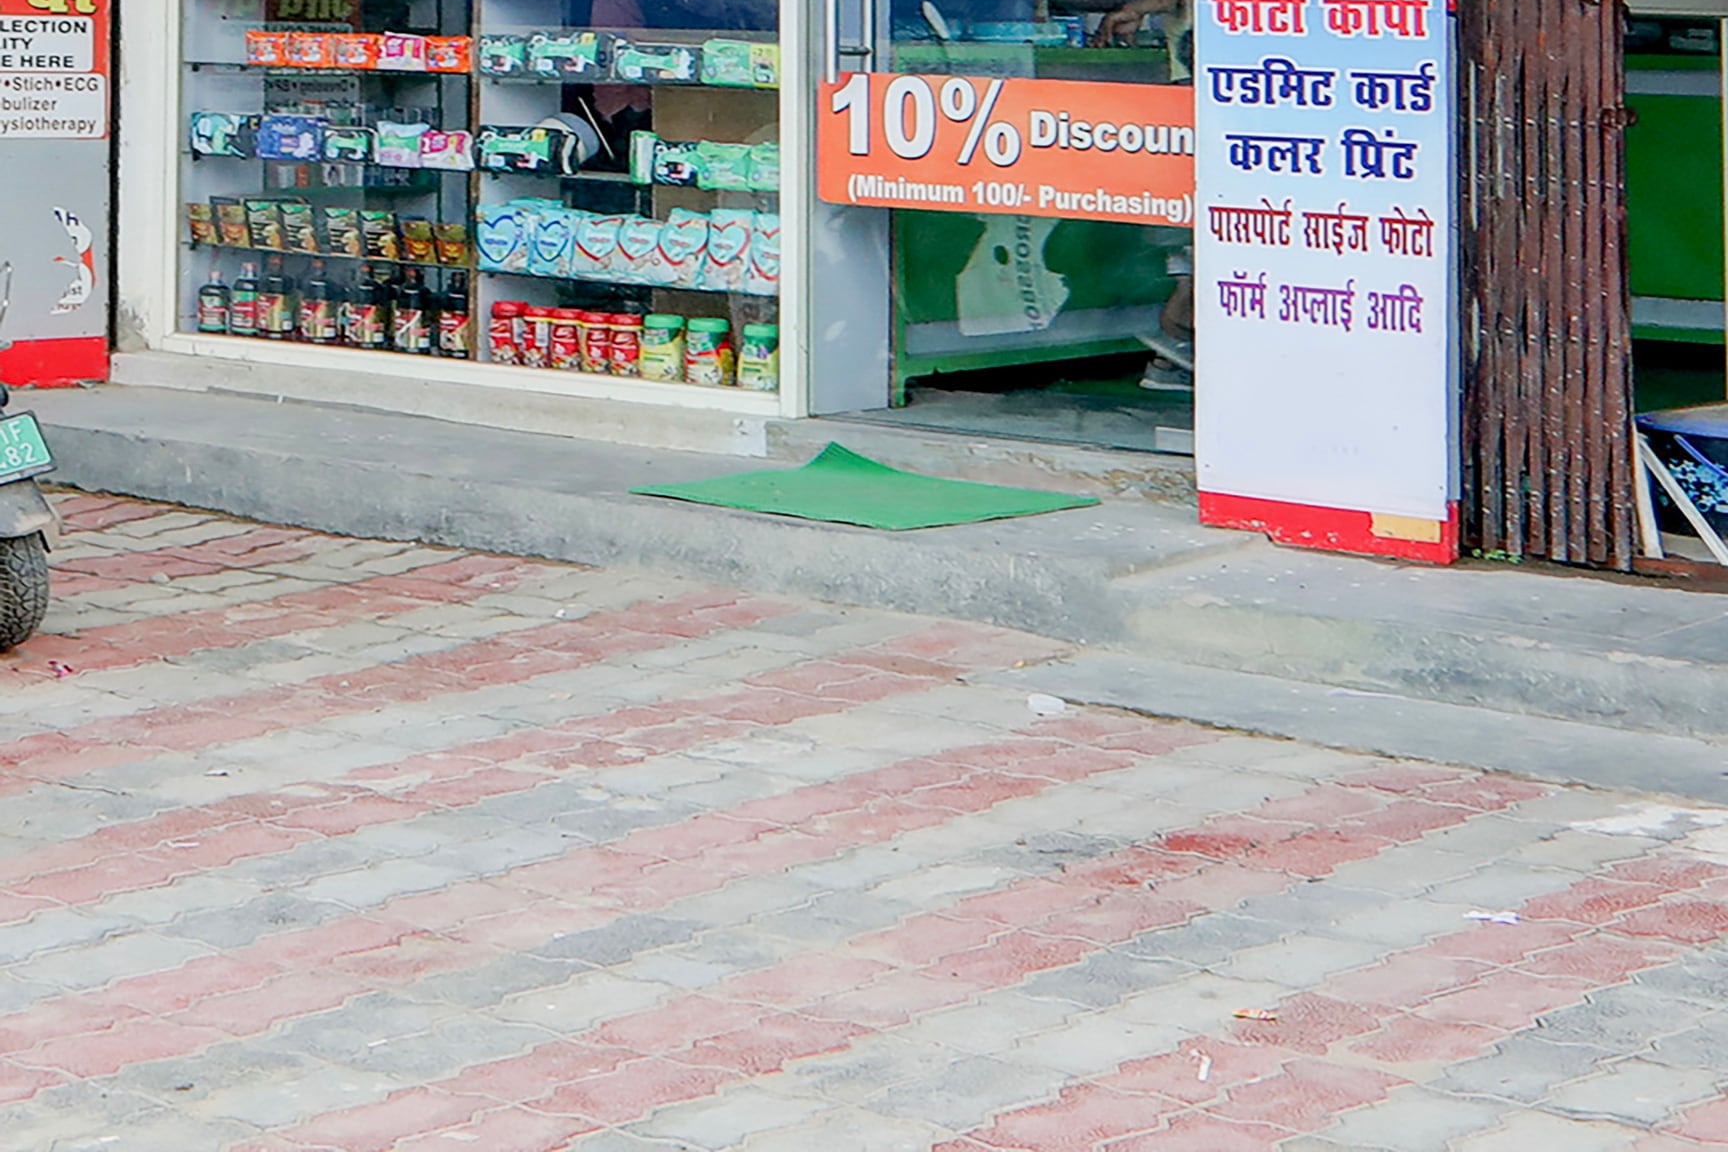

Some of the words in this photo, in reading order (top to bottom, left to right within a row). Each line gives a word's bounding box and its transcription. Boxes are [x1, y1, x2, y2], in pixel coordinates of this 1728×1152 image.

[20, 54, 75, 68] HERE
[1207, 57, 1336, 107] एडमिट
[1349, 62, 1436, 112] कार्ड
[832, 73, 1022, 168] 10%
[1029, 108, 1194, 156] Discoun
[1224, 133, 1326, 175] कलर
[1340, 128, 1418, 180] प्रिंट
[847, 173, 965, 205] (Minimum
[972, 180, 1033, 209] 100/-
[1037, 185, 1194, 226] Purchasing)
[1207, 198, 1293, 247] पासपोर्ट
[1301, 202, 1370, 256] साईज
[1378, 206, 1435, 258] फोटो
[1216, 270, 1267, 321] फॉर्म
[1278, 278, 1356, 333] अप्लाई
[1366, 284, 1424, 334] आदि
